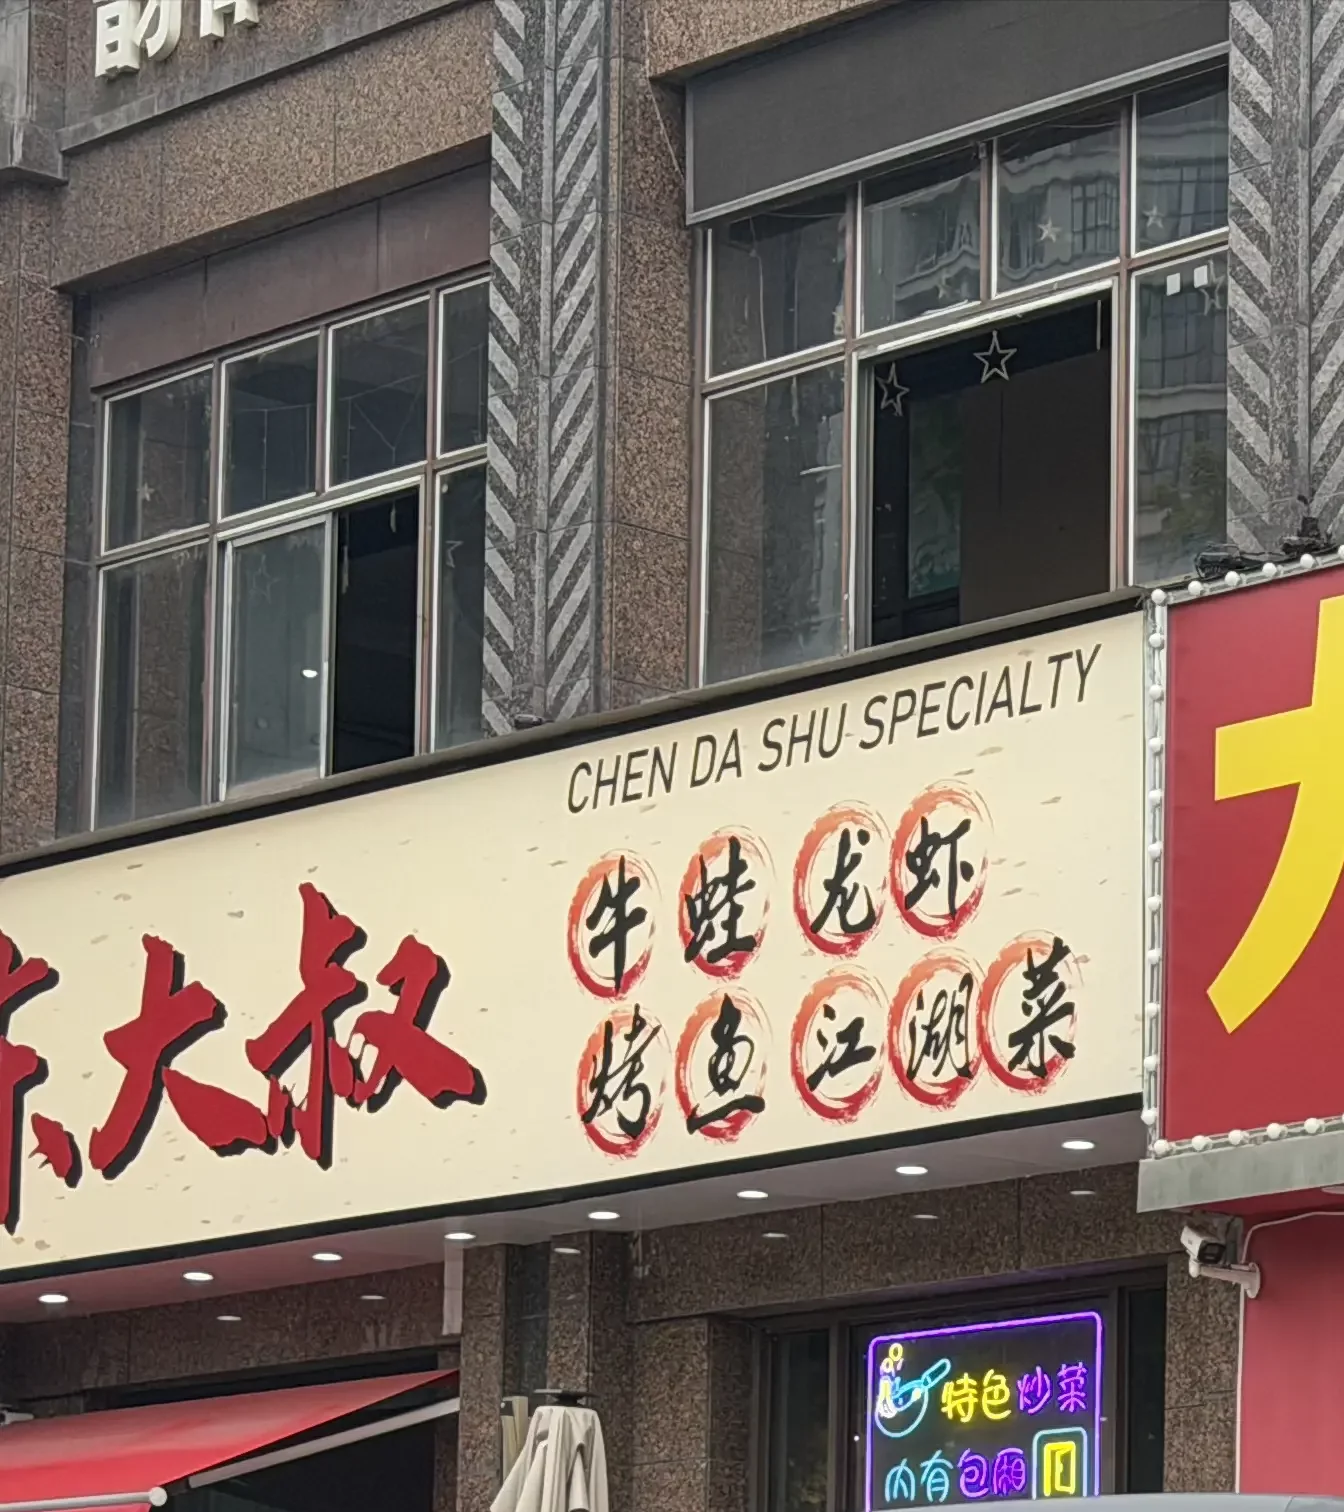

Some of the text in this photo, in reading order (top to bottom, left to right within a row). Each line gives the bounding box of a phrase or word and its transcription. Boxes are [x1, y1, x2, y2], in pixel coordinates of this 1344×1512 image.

[566, 643, 1102, 814] CHEN DA SHU SPECIALTY
[586, 816, 974, 992] 牛蛙 龙虾
[807, 936, 1077, 1093] 江湖菜
[941, 1362, 1087, 1422] 特色炒菜
[884, 1448, 1026, 1503] 内有包厢
